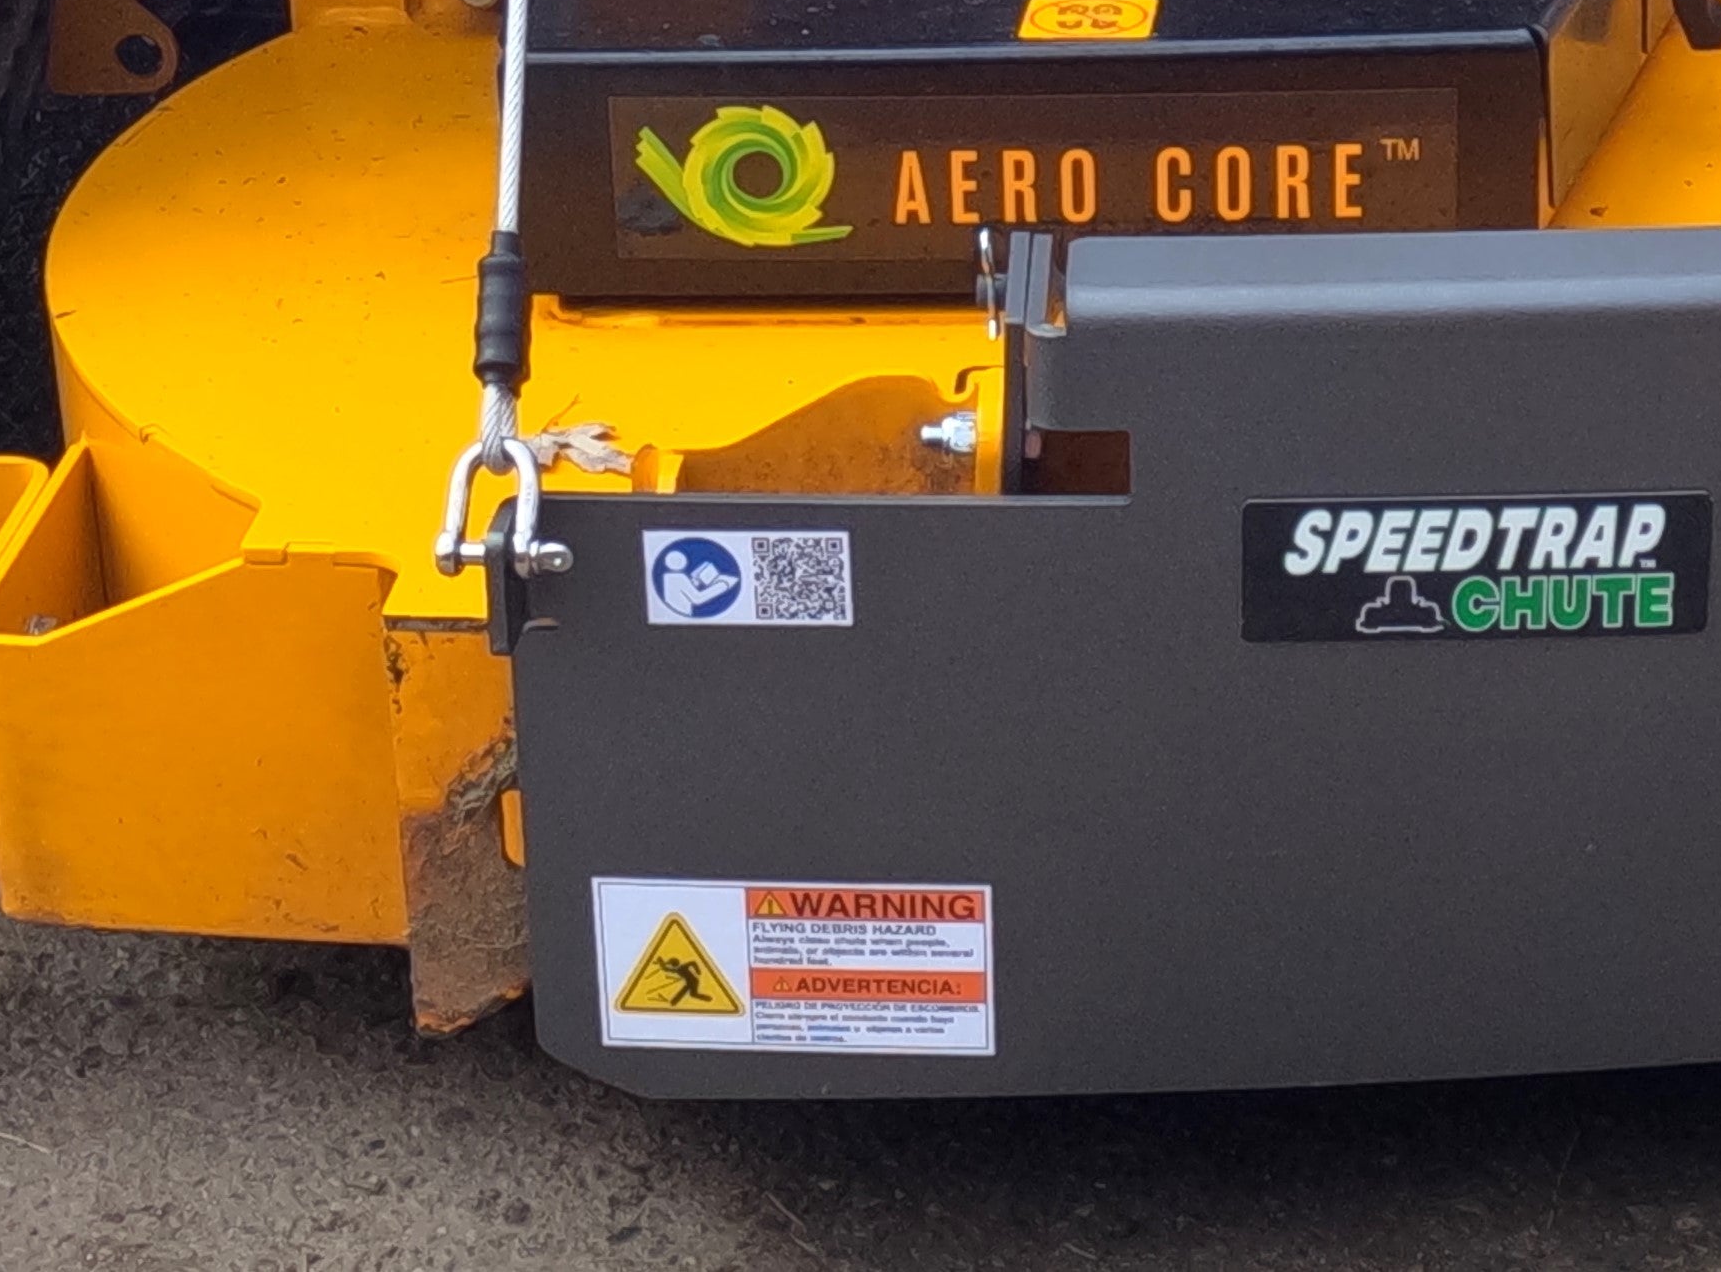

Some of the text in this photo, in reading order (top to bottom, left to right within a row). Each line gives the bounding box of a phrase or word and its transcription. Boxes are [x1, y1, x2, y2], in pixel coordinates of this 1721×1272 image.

[892, 147, 1099, 227] AERO
[1155, 141, 1365, 222] CORE
[1284, 503, 1667, 576] SPEEDTRAP
[1451, 572, 1675, 632] CHUTE
[789, 891, 977, 920] WARNING
[752, 922, 937, 937] FLYING DEBRIS HAZARD
[797, 976, 962, 997] ADVERTENCIA:
